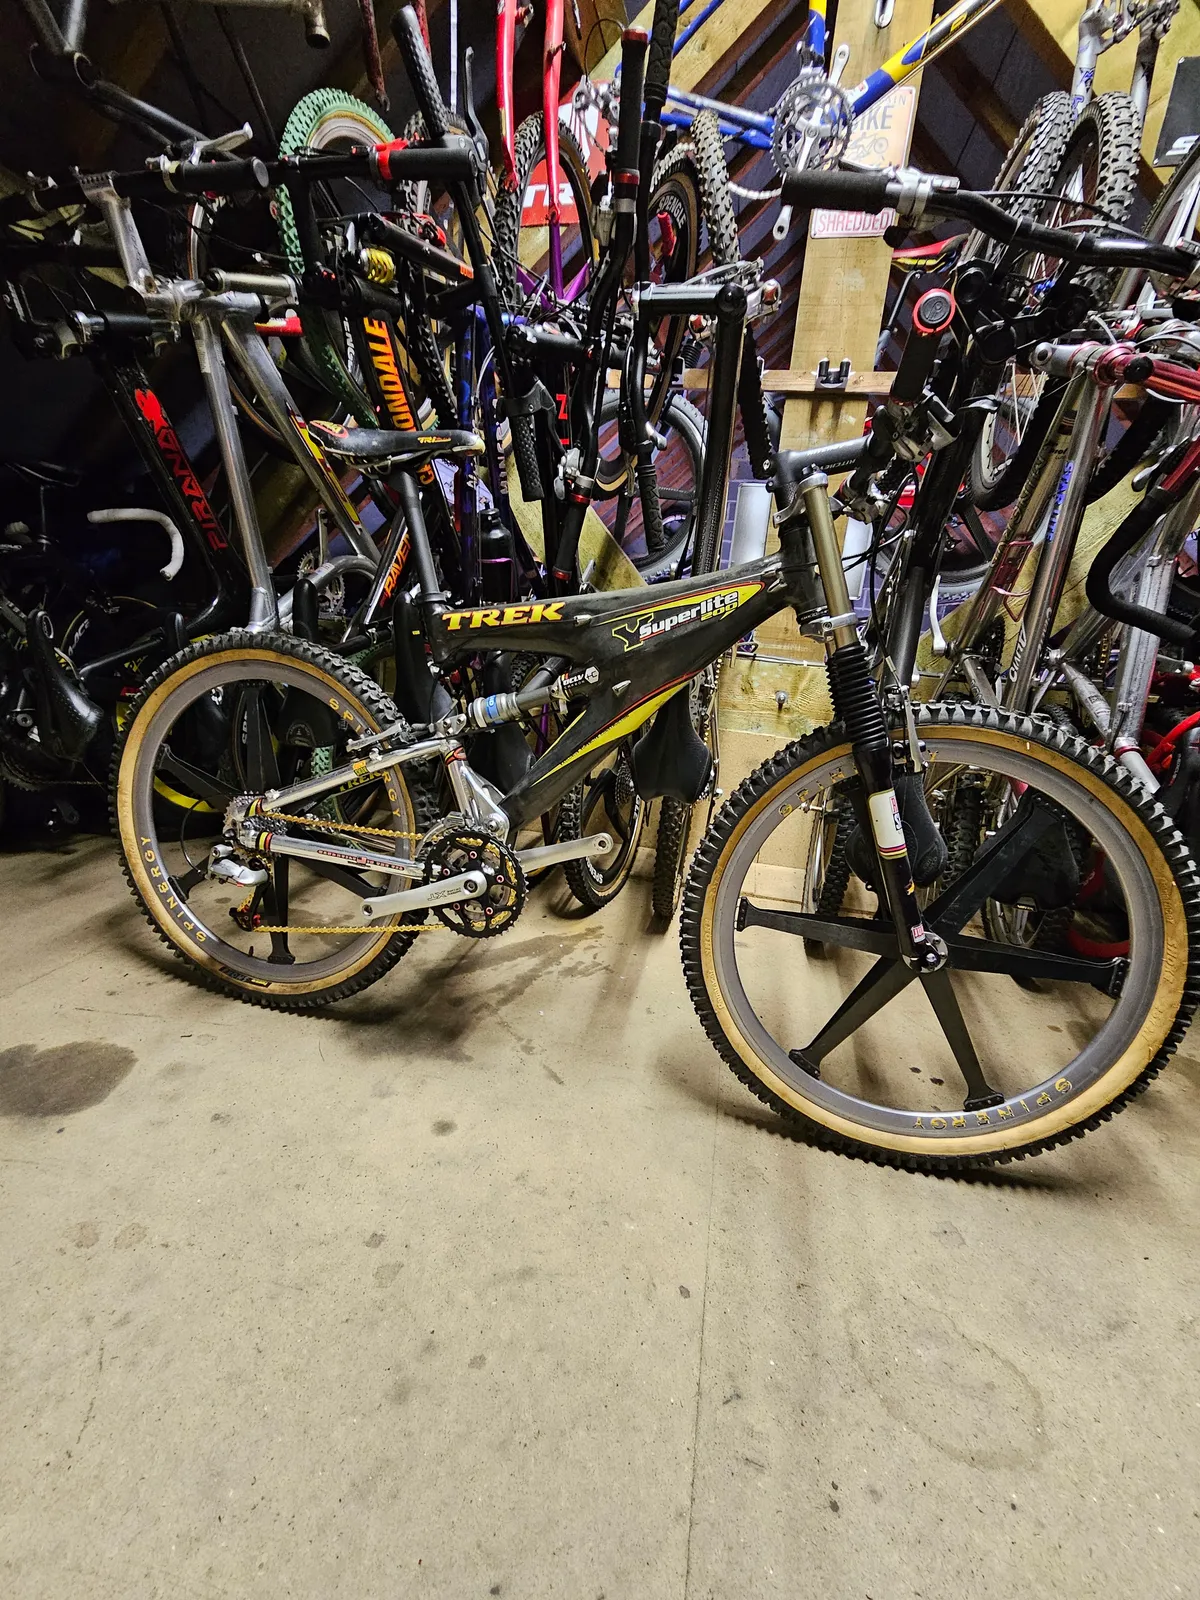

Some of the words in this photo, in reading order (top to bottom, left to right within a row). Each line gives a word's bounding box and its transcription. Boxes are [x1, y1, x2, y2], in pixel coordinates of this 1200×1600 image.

[817, 209, 891, 233] SHREDDED
[441, 601, 566, 631] TREK
[700, 601, 738, 622] 200
[140, 836, 207, 943] SPINERGY
[912, 1076, 1074, 1130] SPINERGY
